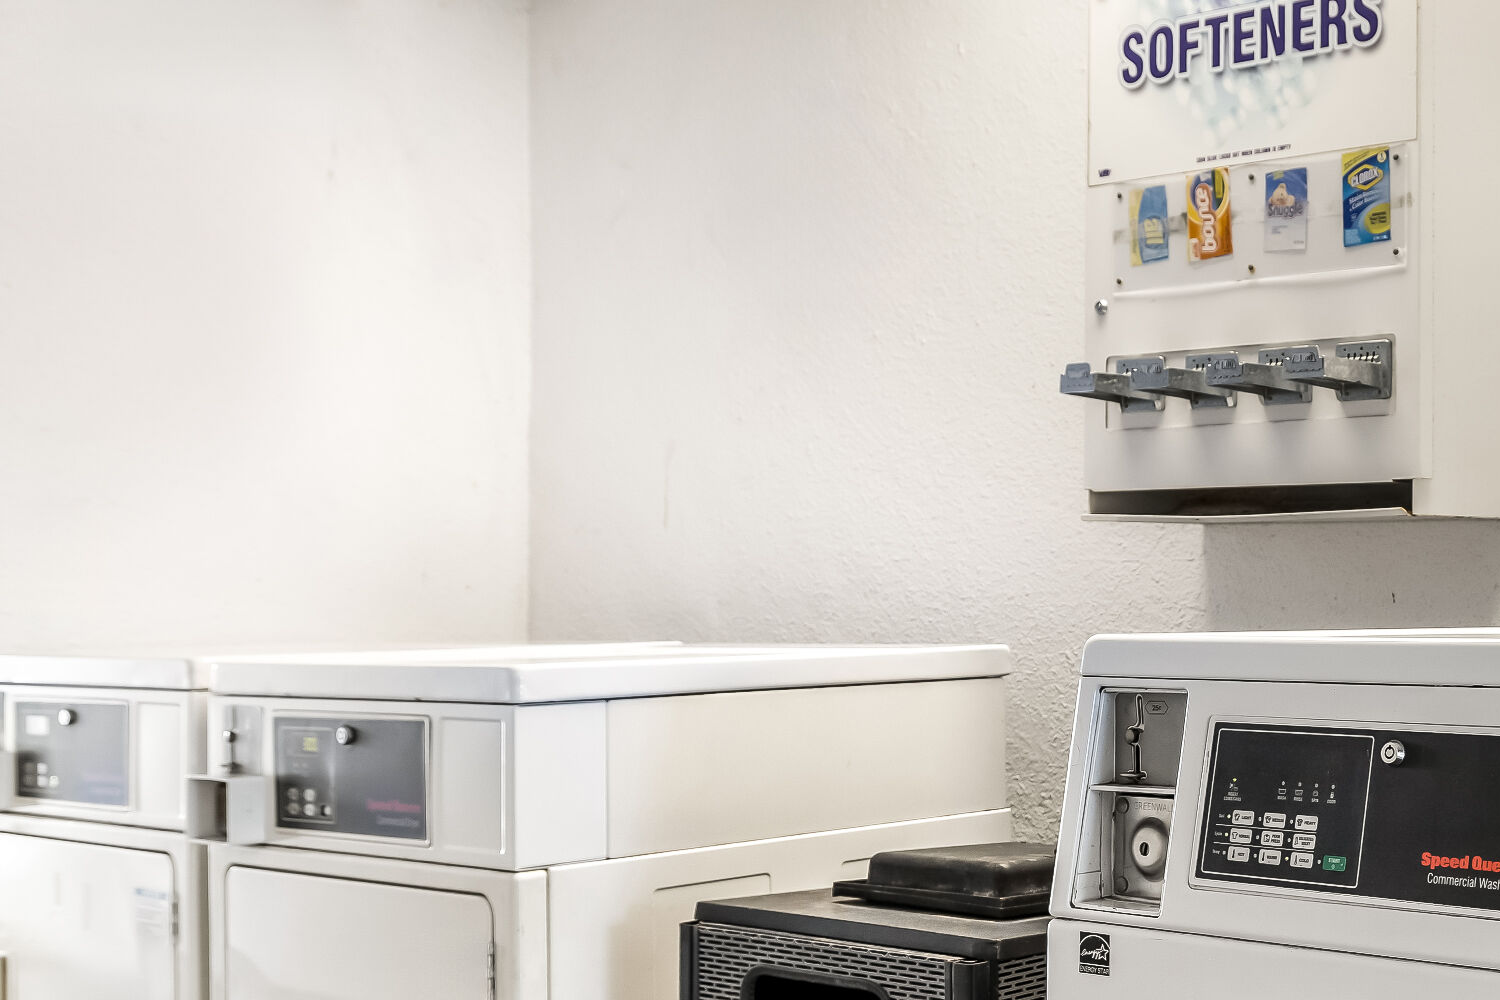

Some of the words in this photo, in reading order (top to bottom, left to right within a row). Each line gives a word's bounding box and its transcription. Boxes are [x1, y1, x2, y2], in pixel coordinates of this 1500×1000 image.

[1122, 0, 1379, 84] SOFTENERS
[1421, 852, 1470, 870] Speed
[1427, 872, 1477, 888] Commercial
